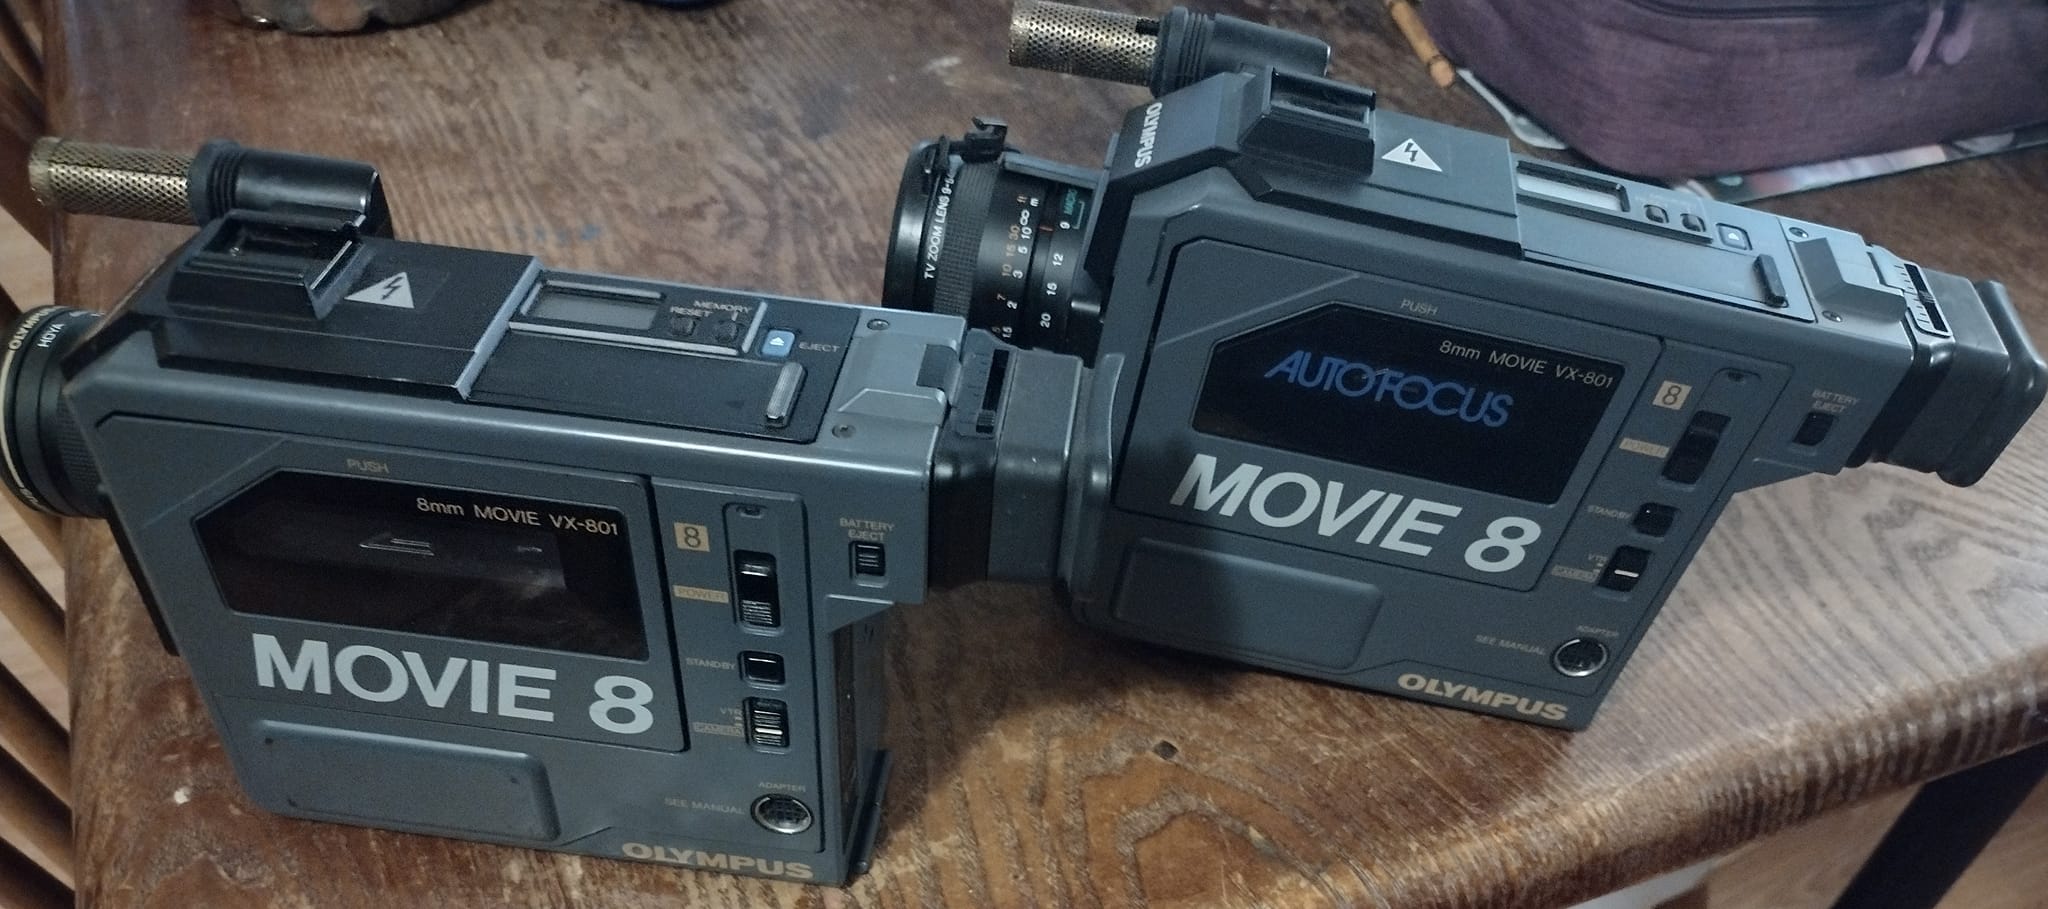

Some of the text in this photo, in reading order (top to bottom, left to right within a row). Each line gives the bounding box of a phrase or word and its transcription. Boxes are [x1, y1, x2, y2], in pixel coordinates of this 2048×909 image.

[1134, 102, 1163, 168] OLYMPUS
[934, 195, 950, 224] LENS
[1021, 226, 1032, 240] 10
[927, 225, 943, 262] ZOOM
[1052, 252, 1064, 267] 12
[924, 263, 936, 280] TV
[1012, 269, 1023, 279] 3
[670, 306, 714, 318] RESET
[693, 300, 752, 314] MEMORY
[1006, 300, 1018, 310] 2
[1400, 298, 1439, 317] PUSH
[1040, 312, 1052, 329] 20
[37, 323, 65, 348] HOYA
[798, 343, 840, 353] EJECT
[1439, 340, 1614, 390] 8mm MOVIE VX-801
[1661, 385, 1683, 406] 8
[1811, 388, 1859, 405] BATTERY
[1812, 400, 1845, 413] EJECT
[346, 458, 390, 474] PUSH
[416, 497, 619, 537] 8mm MOVIE VX-801
[1169, 453, 1542, 573] MOVIE 8
[839, 517, 895, 532] BATTERY
[683, 526, 701, 549] 8
[847, 529, 885, 541] EJECT
[252, 633, 655, 735] MOVIE 8
[1397, 673, 1569, 721] OLYMPUS
[758, 781, 806, 793] ADAPTER
[663, 797, 745, 815] SEE MANUAL
[622, 842, 814, 880] OLYMPUS
